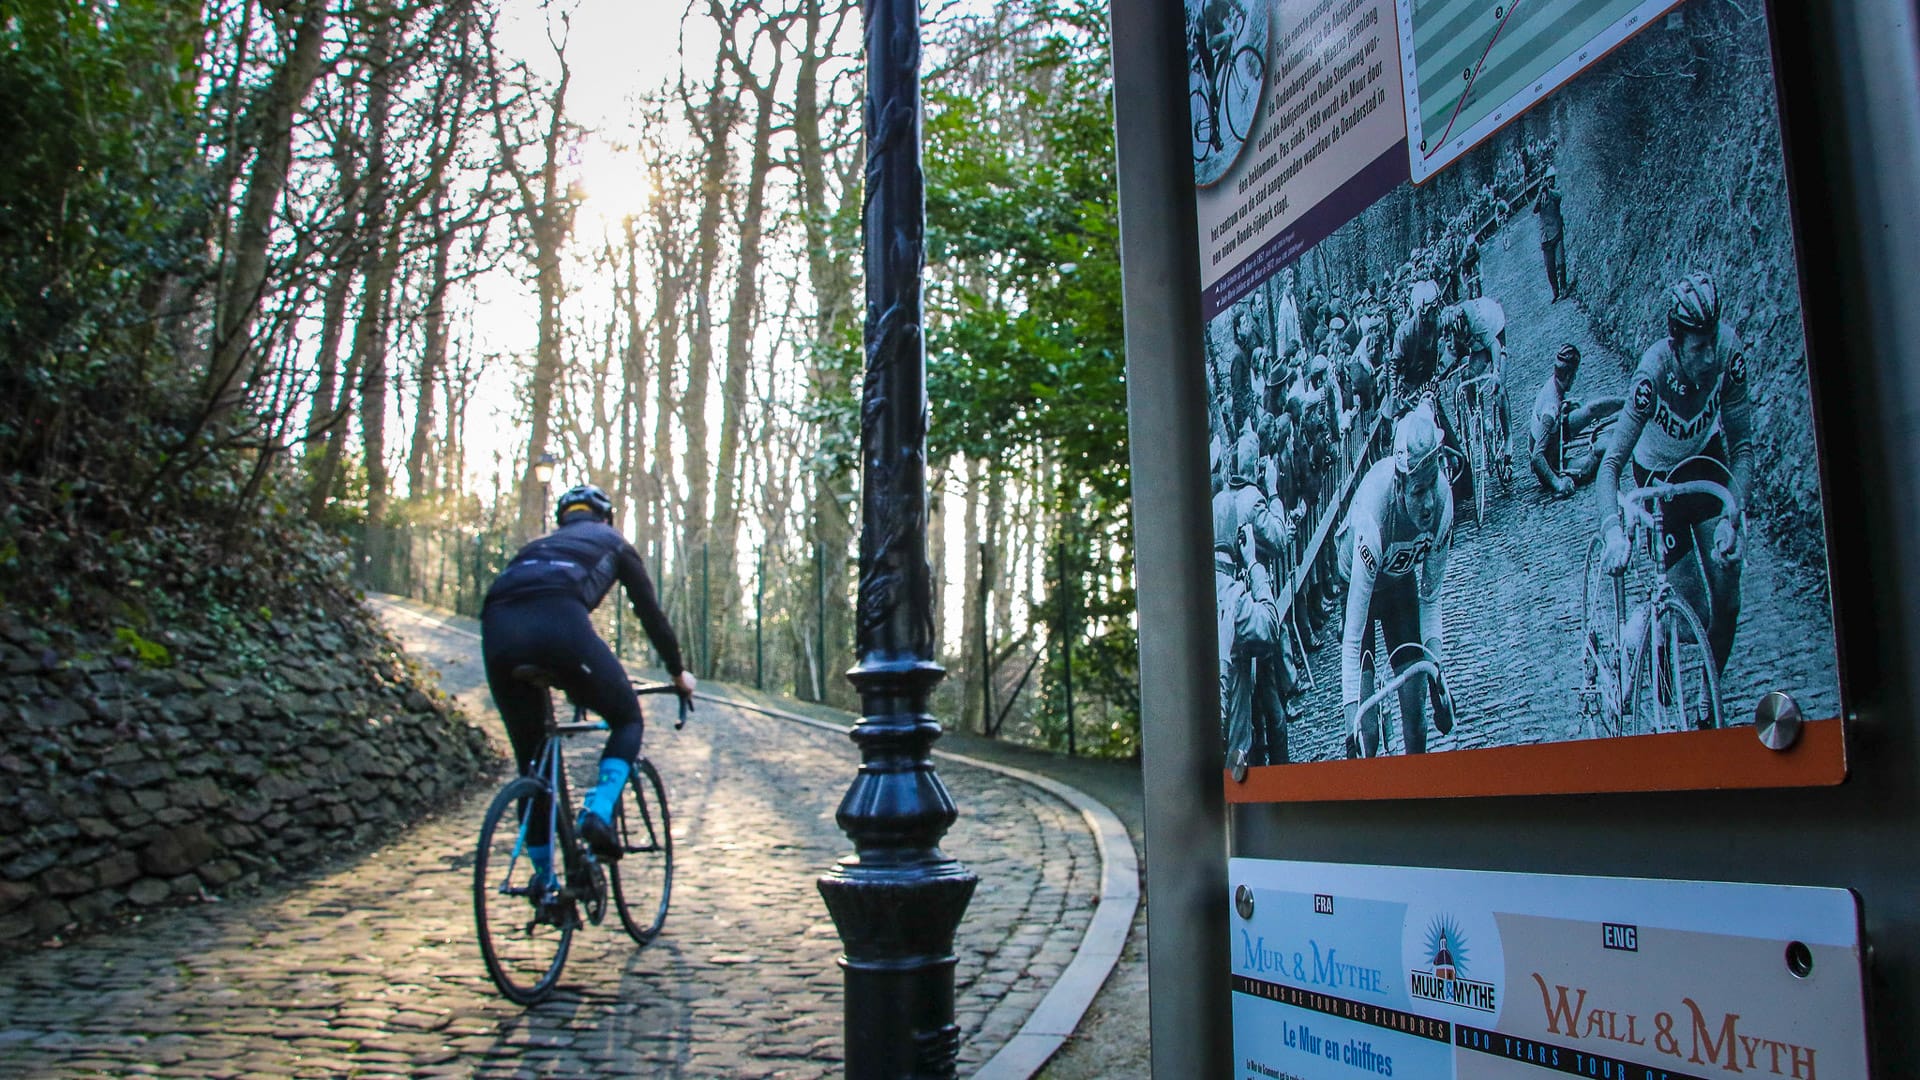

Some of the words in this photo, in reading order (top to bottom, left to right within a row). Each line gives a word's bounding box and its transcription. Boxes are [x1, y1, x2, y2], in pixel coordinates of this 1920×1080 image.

[1332, 0, 1366, 30] Abdijstra
[1279, 142, 1290, 160] Pas
[1321, 95, 1338, 123] wordt
[1349, 74, 1366, 100] Muur
[1366, 60, 1382, 85] door
[1255, 183, 1266, 206] stad
[1331, 124, 1339, 143] de
[1340, 93, 1377, 135] Denderstad
[1377, 88, 1386, 105] in
[1315, 896, 1333, 913] FRA
[1605, 926, 1637, 949] ENG
[1293, 952, 1307, 985] &
[1266, 985, 1285, 1002] ANS
[1292, 989, 1304, 1006] DE
[1310, 994, 1338, 1014] TOUR
[1346, 1002, 1367, 1022] DES
[1375, 1008, 1444, 1040] FLANDRES
[1654, 1012, 1682, 1057] &
[1283, 1020, 1296, 1048] Le
[1300, 1025, 1321, 1055] Mur
[1325, 1041, 1339, 1063] en
[1342, 1040, 1393, 1078] chiffres
[1463, 1029, 1490, 1050] 100
[1505, 1040, 1559, 1067] YEARS
[1576, 1055, 1626, 1080] TOUR
